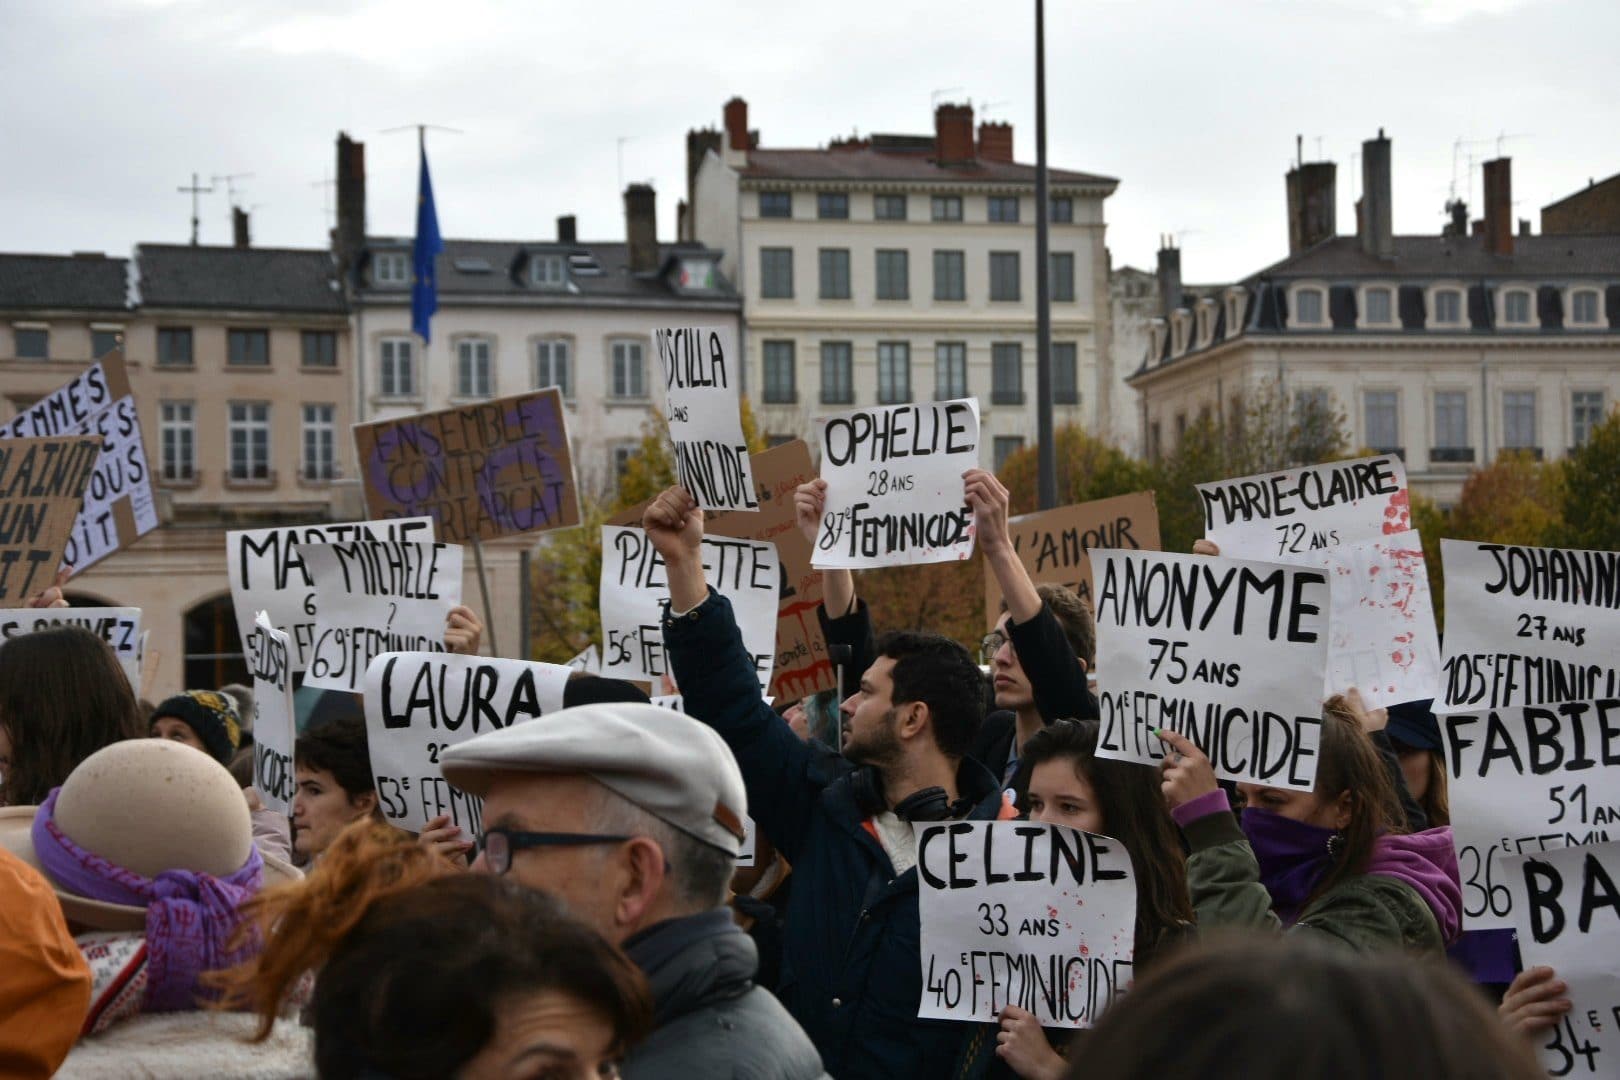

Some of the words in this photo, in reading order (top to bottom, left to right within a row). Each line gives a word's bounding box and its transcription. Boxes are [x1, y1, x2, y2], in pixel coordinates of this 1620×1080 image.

[373, 398, 541, 463] ENSEMBLE
[825, 404, 975, 466] OPHELIE
[388, 448, 507, 505] CONTRE
[516, 440, 554, 483] LE
[867, 469, 888, 496] 28
[891, 475, 914, 492] ANS
[1201, 459, 1399, 530] MARIE-CLAIRE
[1275, 522, 1307, 556] 72
[1310, 530, 1341, 551] ANS
[332, 542, 447, 600] MICHELE
[1097, 556, 1326, 644] ANONYME
[1516, 613, 1548, 640] 27
[1552, 625, 1586, 647] ANS
[1148, 638, 1189, 685] 75
[1192, 659, 1241, 688] ANS
[1491, 653, 1620, 708] FEMINICI
[381, 656, 542, 733] LAURA
[1133, 691, 1323, 786] FEMINICIDE
[1548, 783, 1588, 825] 51
[918, 822, 1129, 889] CELINE
[978, 902, 1009, 937] 33
[1019, 918, 1060, 937] ANS
